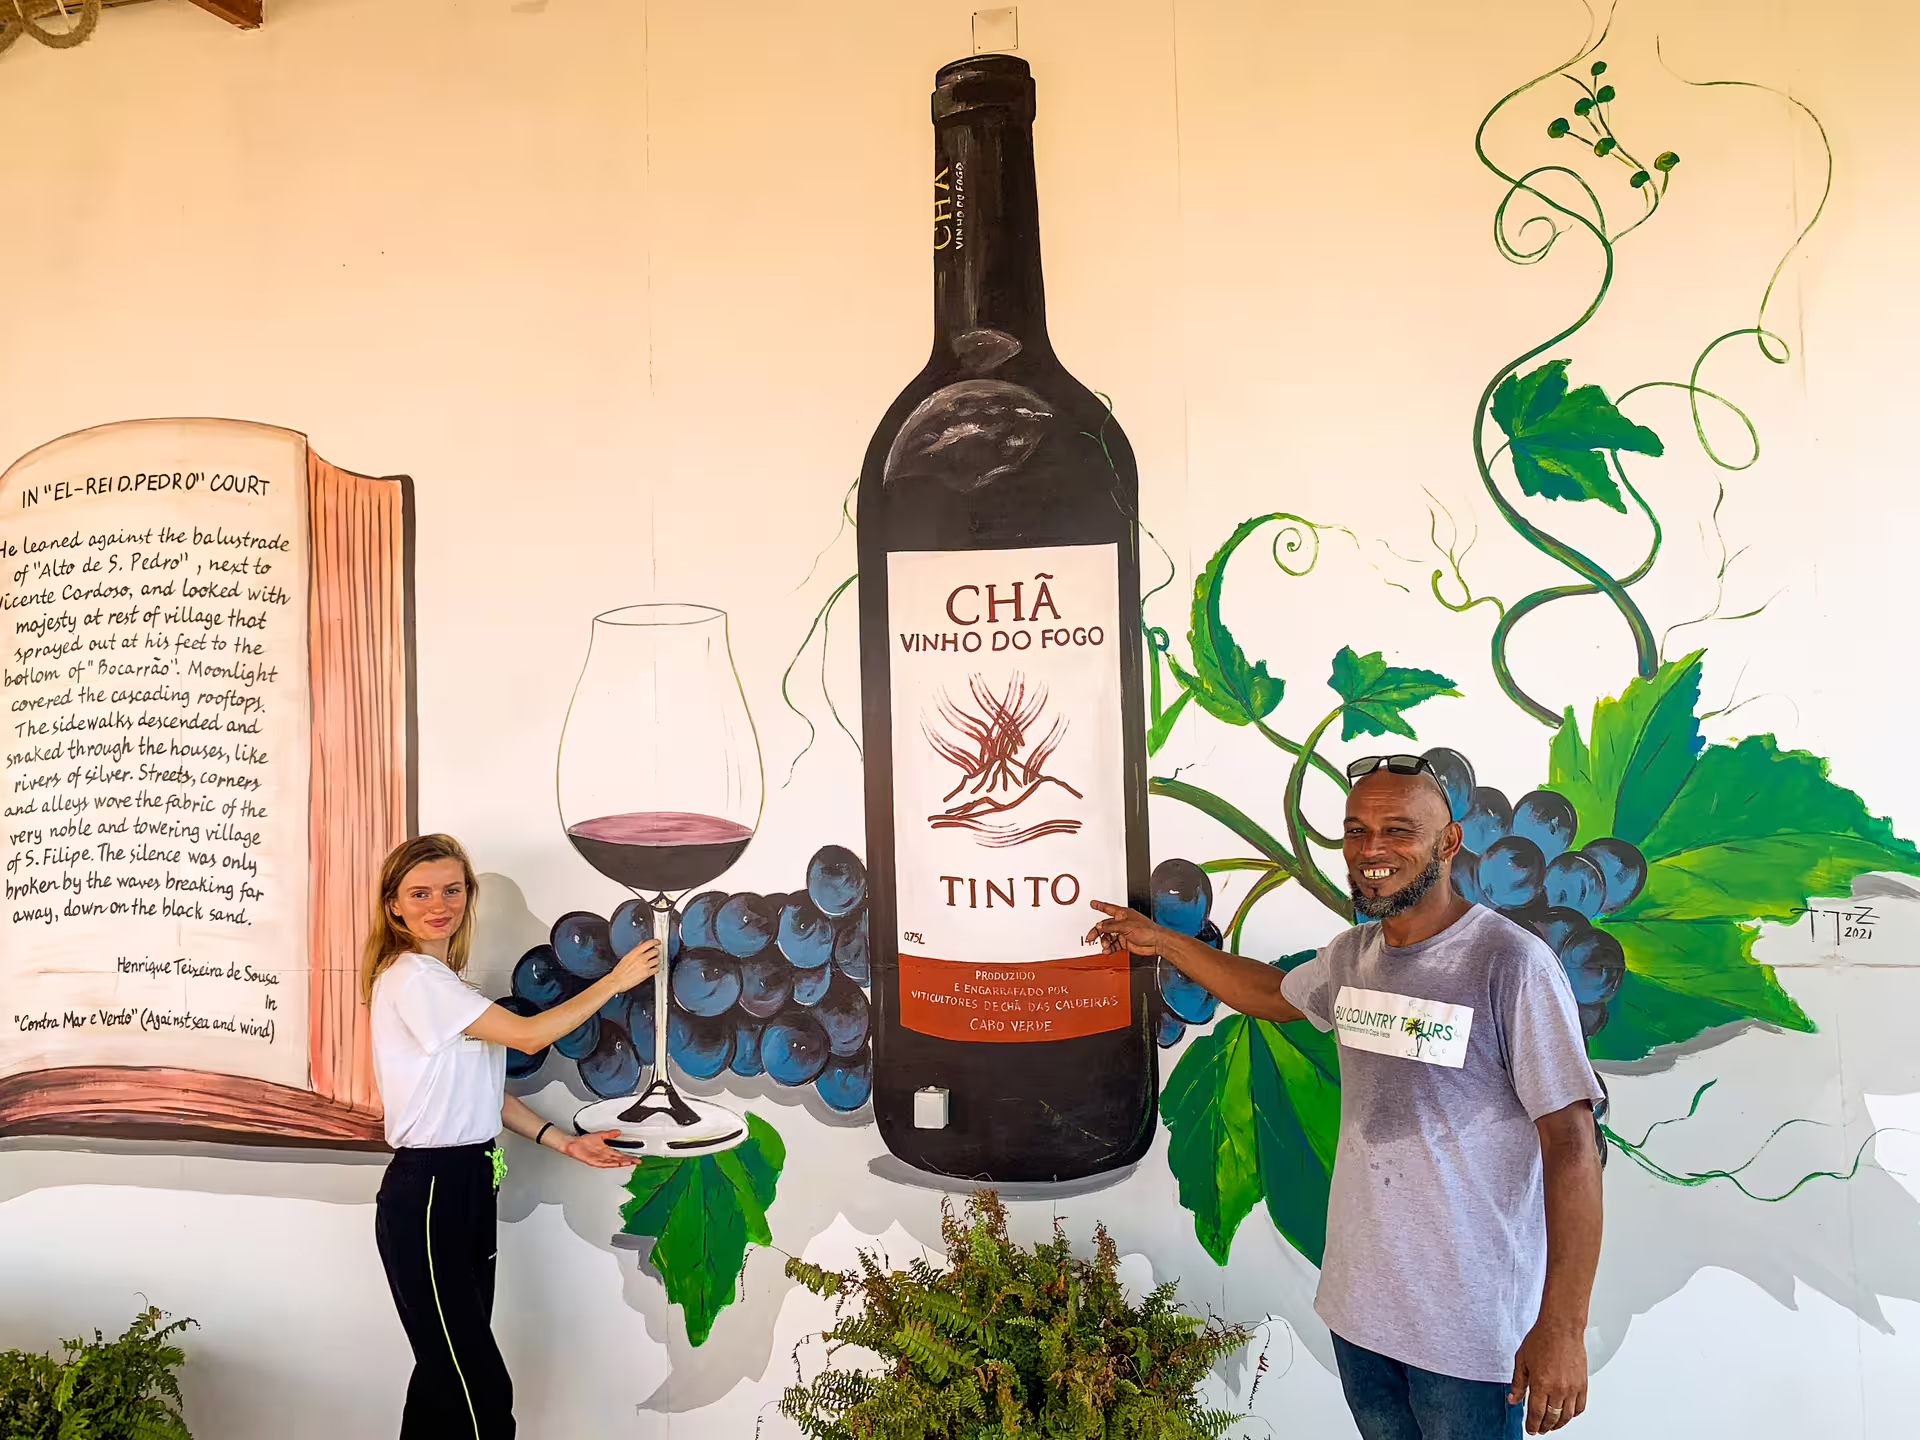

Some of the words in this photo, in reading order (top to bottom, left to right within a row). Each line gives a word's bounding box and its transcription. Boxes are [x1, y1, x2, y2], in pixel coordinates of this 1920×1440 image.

[956, 162, 965, 191] FOGO
[956, 194, 965, 208] DO
[956, 210, 965, 250] VINHO
[22, 487, 38, 508] IN
[210, 474, 270, 496] COURT
[24, 531, 84, 554] leaned
[89, 529, 154, 550] against
[158, 527, 187, 544] the
[193, 526, 291, 552] balustrade
[14, 561, 29, 586] of
[83, 557, 102, 573] de
[108, 555, 123, 573] S.
[209, 557, 248, 575] next
[253, 558, 272, 575] to
[141, 579, 176, 596] and
[183, 579, 242, 598] looked
[248, 587, 291, 606] with
[946, 572, 1061, 626] CHÃ
[15, 611, 77, 638] majesty
[84, 608, 103, 625] at
[108, 605, 139, 624] rest
[143, 606, 161, 628] of
[164, 607, 224, 630] village
[228, 609, 267, 630] that
[14, 635, 84, 665] sprayed
[89, 634, 116, 651] out
[121, 633, 138, 648] at
[145, 633, 170, 648] his
[175, 634, 207, 654] feet
[210, 635, 227, 651] to
[234, 636, 265, 655] the
[900, 631, 982, 653] VINHO
[992, 630, 1032, 651] DO
[1041, 626, 1104, 649] FOGO
[68, 660, 85, 683] of
[188, 660, 278, 687] Moonlight
[11, 689, 72, 713] covered
[78, 686, 108, 703] the
[111, 685, 190, 708] cascading
[197, 690, 265, 715] rooftops.
[15, 720, 50, 738] The
[52, 711, 134, 733] sidewalks
[138, 710, 223, 731] descended
[226, 714, 263, 734] and
[6, 742, 64, 769] snaked
[68, 736, 135, 762] through
[138, 736, 167, 755] the
[170, 738, 230, 763] houses,
[235, 743, 269, 764] like
[15, 774, 61, 793] rivers
[67, 766, 82, 788] of
[85, 766, 134, 785] silver.
[139, 764, 196, 786] Streets,
[200, 771, 262, 791] corners
[4, 798, 38, 817] and
[41, 795, 90, 816] alleys
[135, 790, 163, 808] the
[165, 793, 216, 814] fabric
[222, 798, 238, 819] of
[241, 799, 268, 818] the
[10, 827, 42, 846] very
[50, 818, 93, 838] noble
[97, 817, 130, 834] and
[133, 819, 200, 843] towering
[205, 823, 261, 848] village
[6, 853, 22, 874] of
[25, 848, 39, 867] S.
[43, 847, 94, 868] Filipe.
[97, 842, 125, 861] The
[130, 843, 181, 863] silence
[188, 850, 216, 867] was
[222, 852, 257, 877] only
[5, 877, 60, 900] broken
[63, 871, 82, 894] by
[86, 871, 112, 889] the
[116, 875, 161, 890] waves
[165, 871, 234, 901] breaking
[240, 884, 264, 902] far
[940, 873, 1080, 908] TINTO
[12, 906, 58, 925] away,
[64, 898, 108, 918] down
[110, 900, 130, 915] on
[131, 898, 157, 915] the
[162, 897, 204, 920] black
[209, 908, 252, 926] sand.
[1844, 927, 1872, 939] 2021
[117, 956, 172, 979] Henrique
[174, 958, 223, 978] Teixeira
[226, 961, 242, 980] de
[244, 965, 280, 986] Sousa
[975, 970, 1036, 981] PRODUZIDO
[911, 989, 978, 1009] VITICULTORES
[1028, 1002, 1050, 1012] DAS
[1055, 996, 1118, 1010] CALDEIRAS
[954, 982, 960, 992] E
[964, 984, 1044, 997] ENGARRAFADO
[1048, 986, 1068, 995] POR
[63, 1011, 87, 1028] Mar
[90, 1013, 97, 1025] e
[212, 1015, 237, 1033] and
[240, 1020, 275, 1044] wind)
[969, 1018, 1004, 1032] CABO
[1010, 1020, 1053, 1032] VERDE
[1347, 1008, 1397, 1029] COUNTRY
